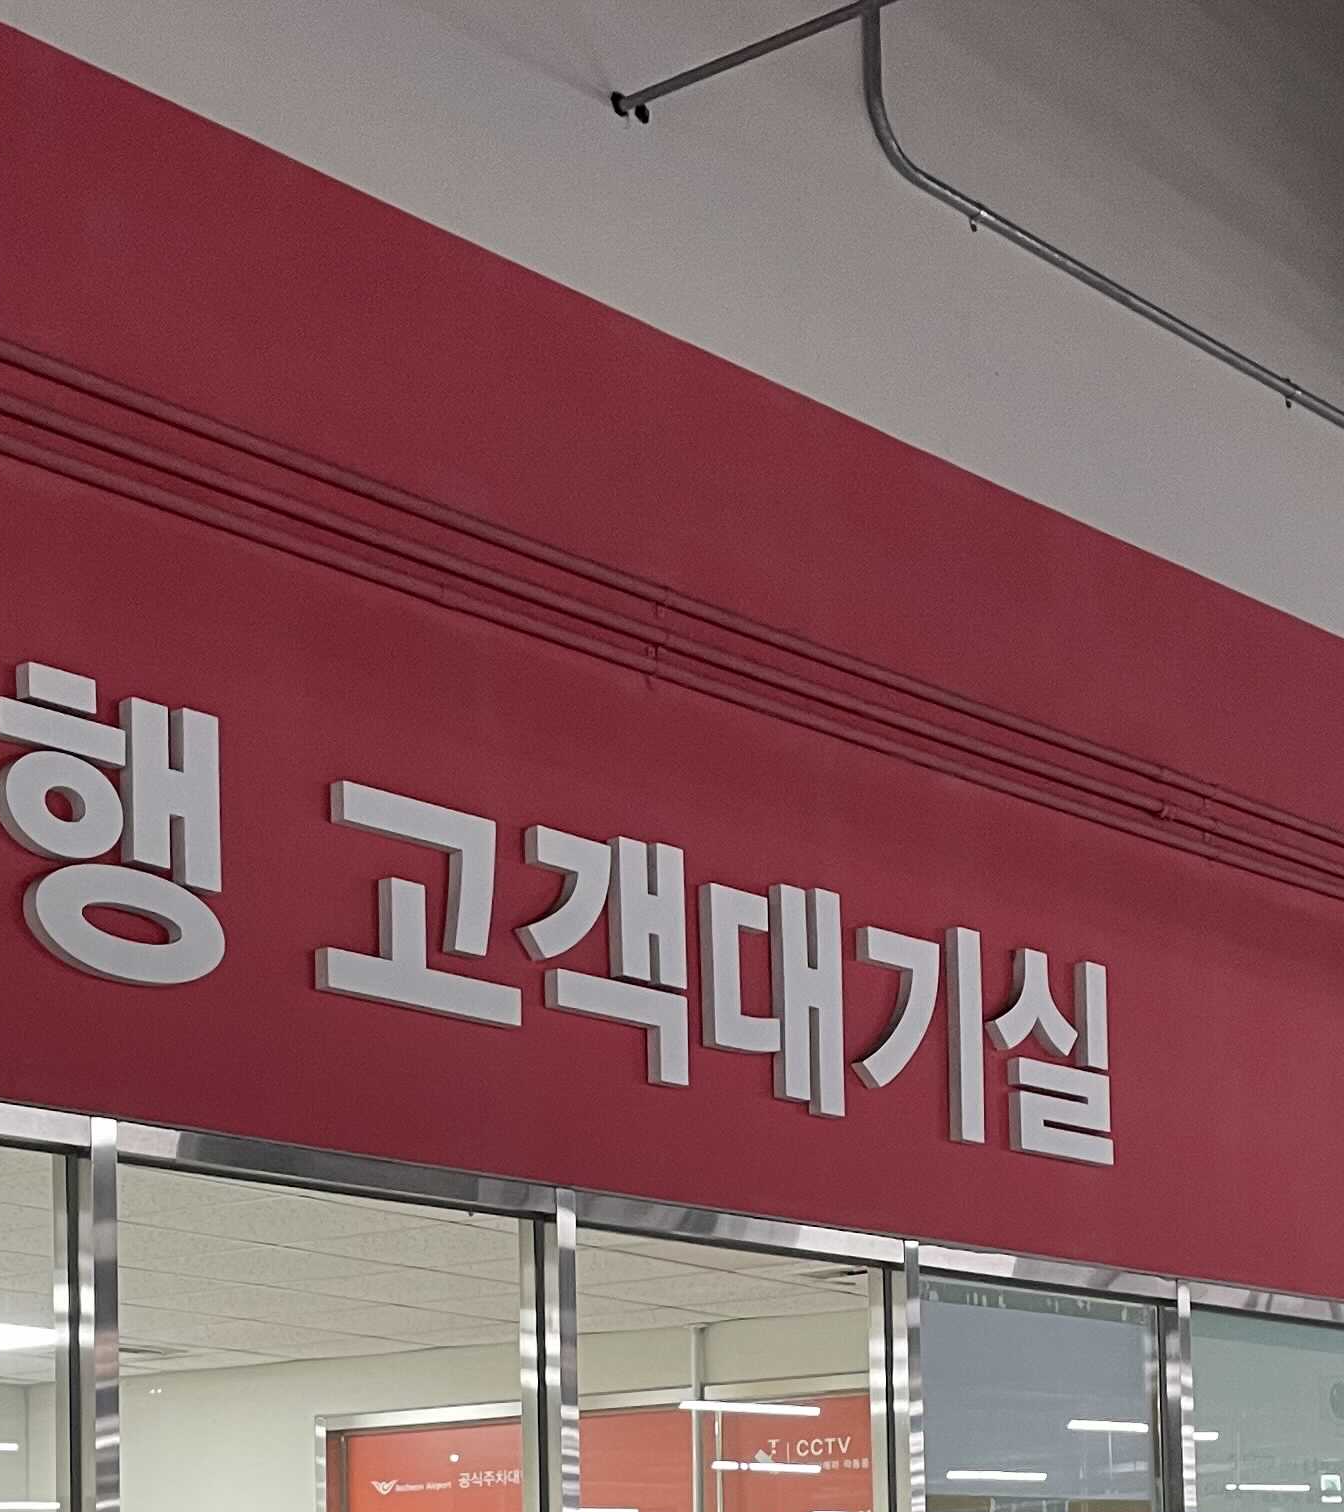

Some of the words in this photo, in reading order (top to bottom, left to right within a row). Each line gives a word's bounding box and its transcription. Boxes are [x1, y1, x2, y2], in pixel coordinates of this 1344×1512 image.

[315, 779, 1114, 1166] 고객대기실
[796, 1436, 851, 1457] CCTV
[458, 1470, 523, 1488] 공식주차대
